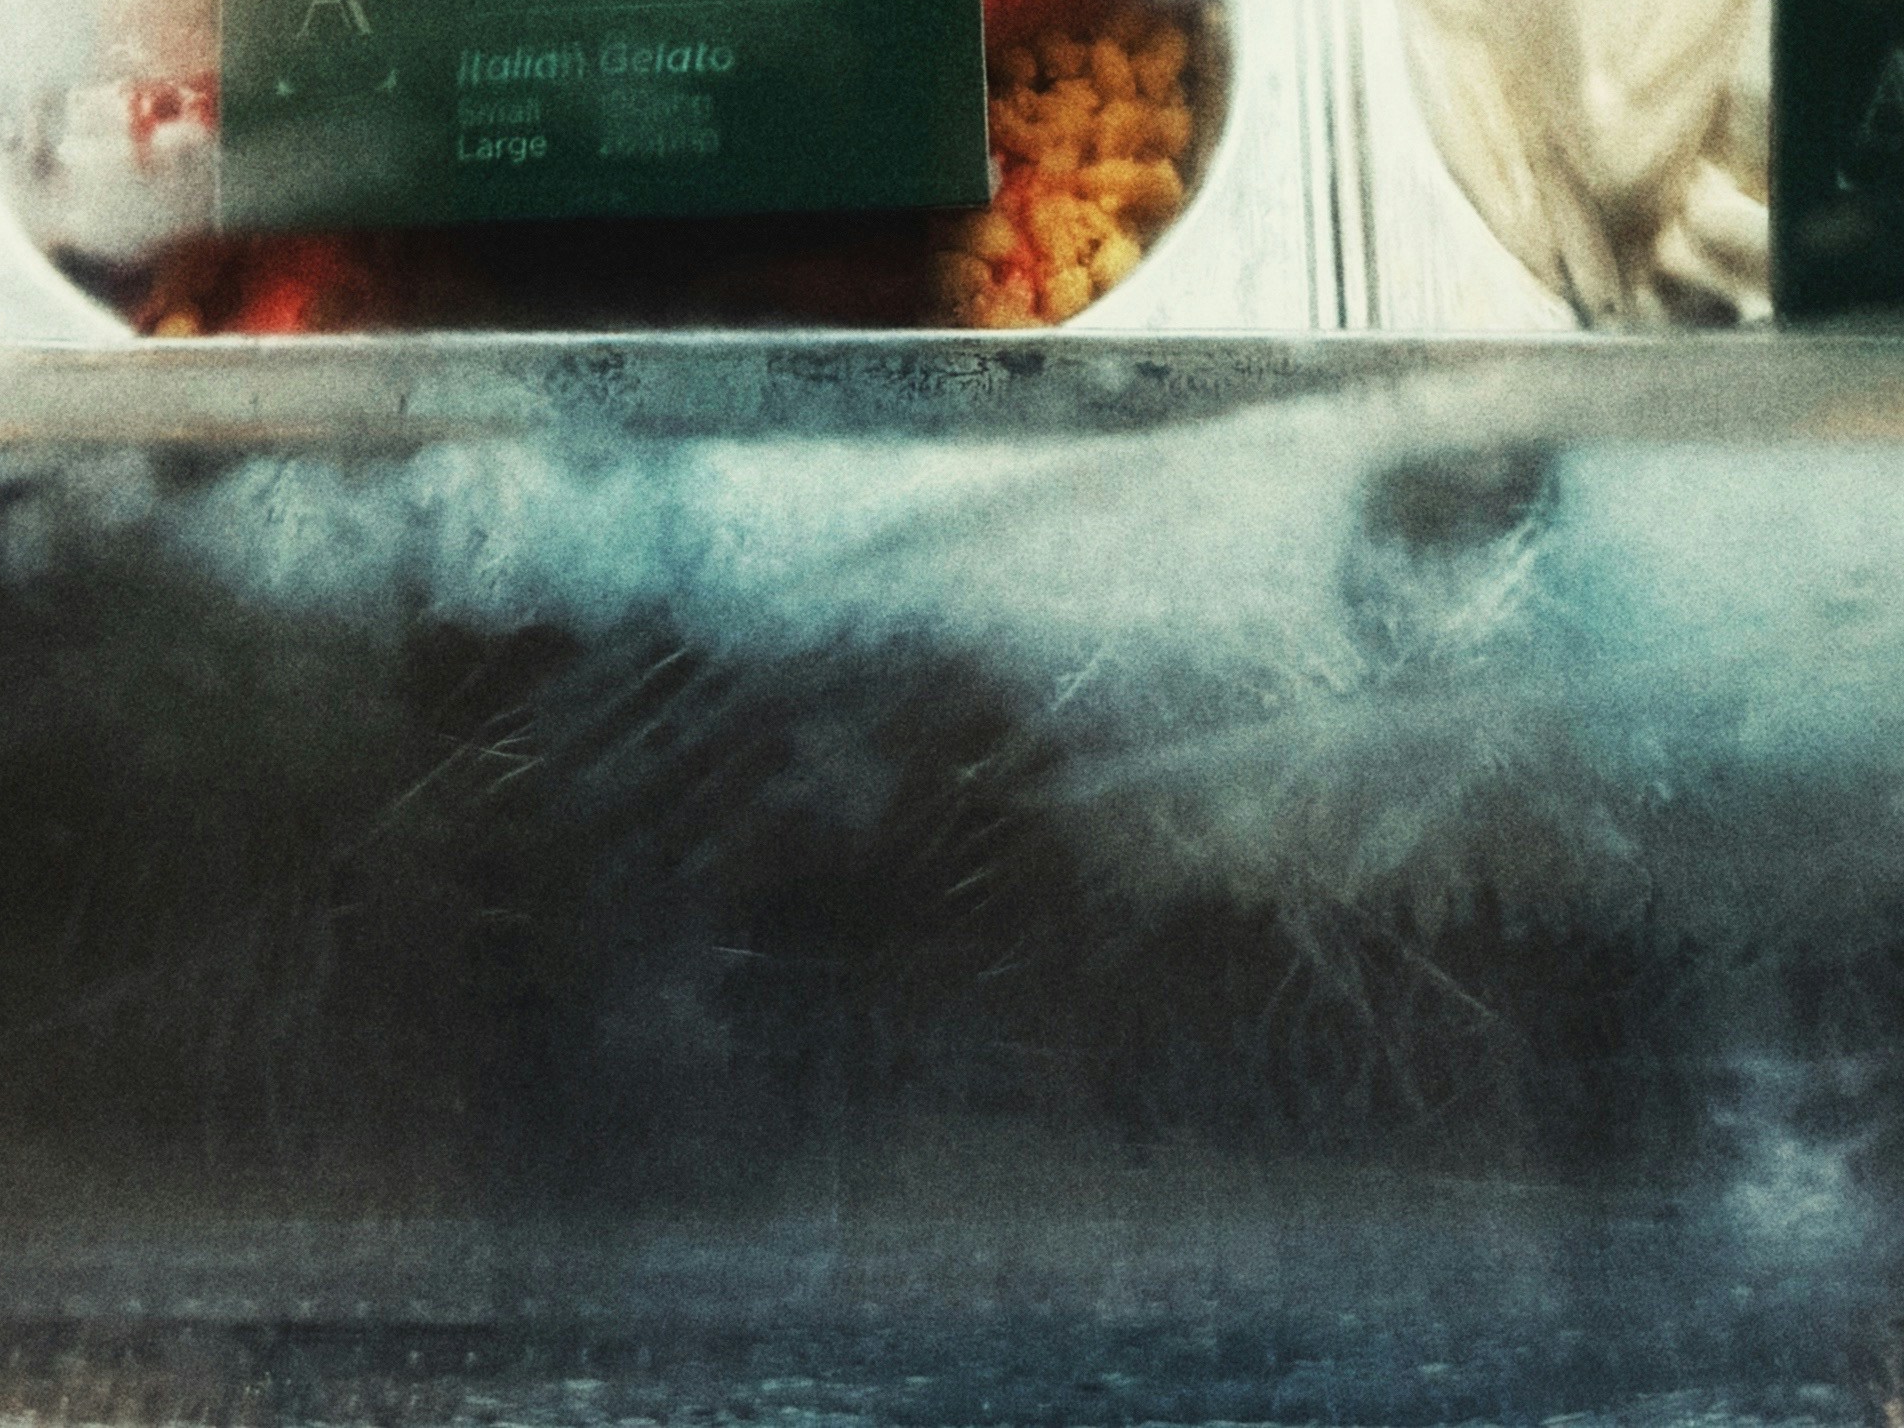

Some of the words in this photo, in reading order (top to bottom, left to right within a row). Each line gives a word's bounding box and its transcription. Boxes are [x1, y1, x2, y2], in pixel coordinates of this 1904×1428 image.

[457, 41, 586, 88] Italian
[600, 38, 736, 75] Gelato
[457, 133, 549, 165] Large
